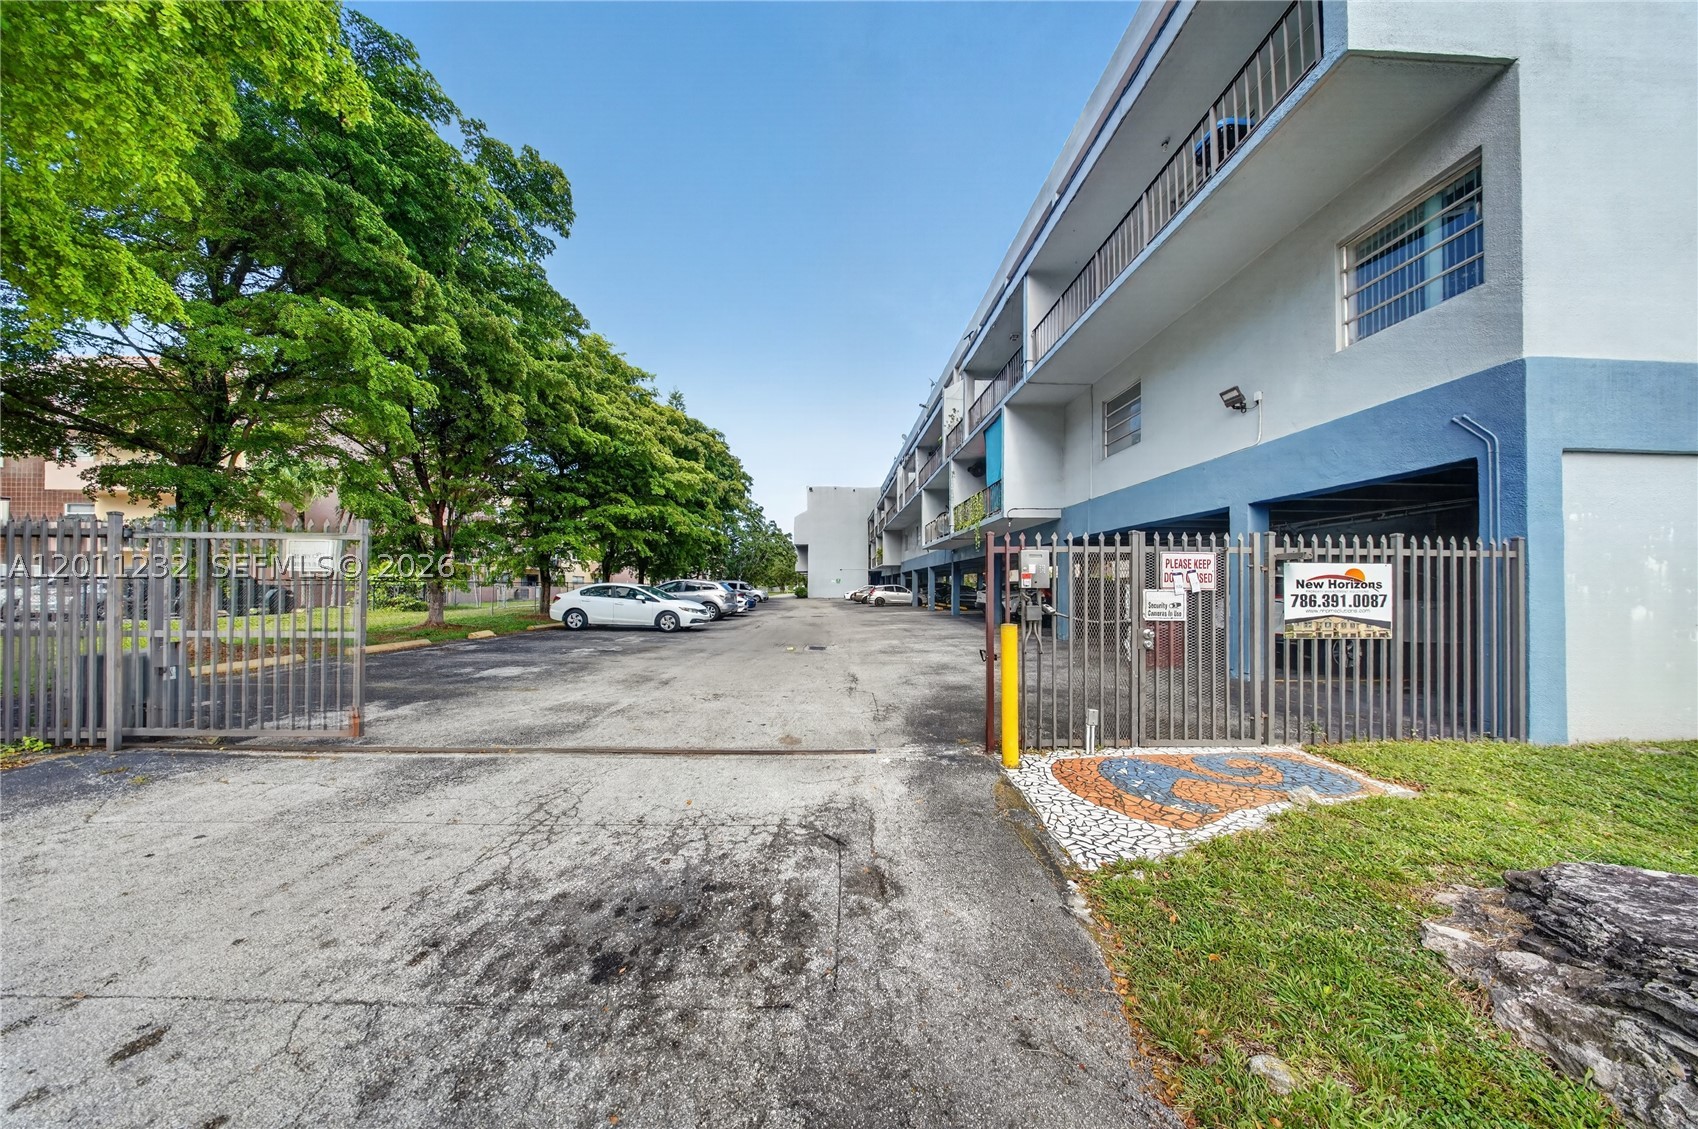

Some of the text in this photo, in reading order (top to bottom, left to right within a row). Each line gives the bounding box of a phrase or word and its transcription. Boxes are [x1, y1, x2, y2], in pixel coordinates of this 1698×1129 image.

[1165, 558, 1212, 569] PLEASE KEEP
[1164, 572, 1184, 583] DO
[1296, 579, 1383, 591] New Horizons
[1148, 601, 1168, 610] Security
[1290, 594, 1388, 608] 786.391.0087
